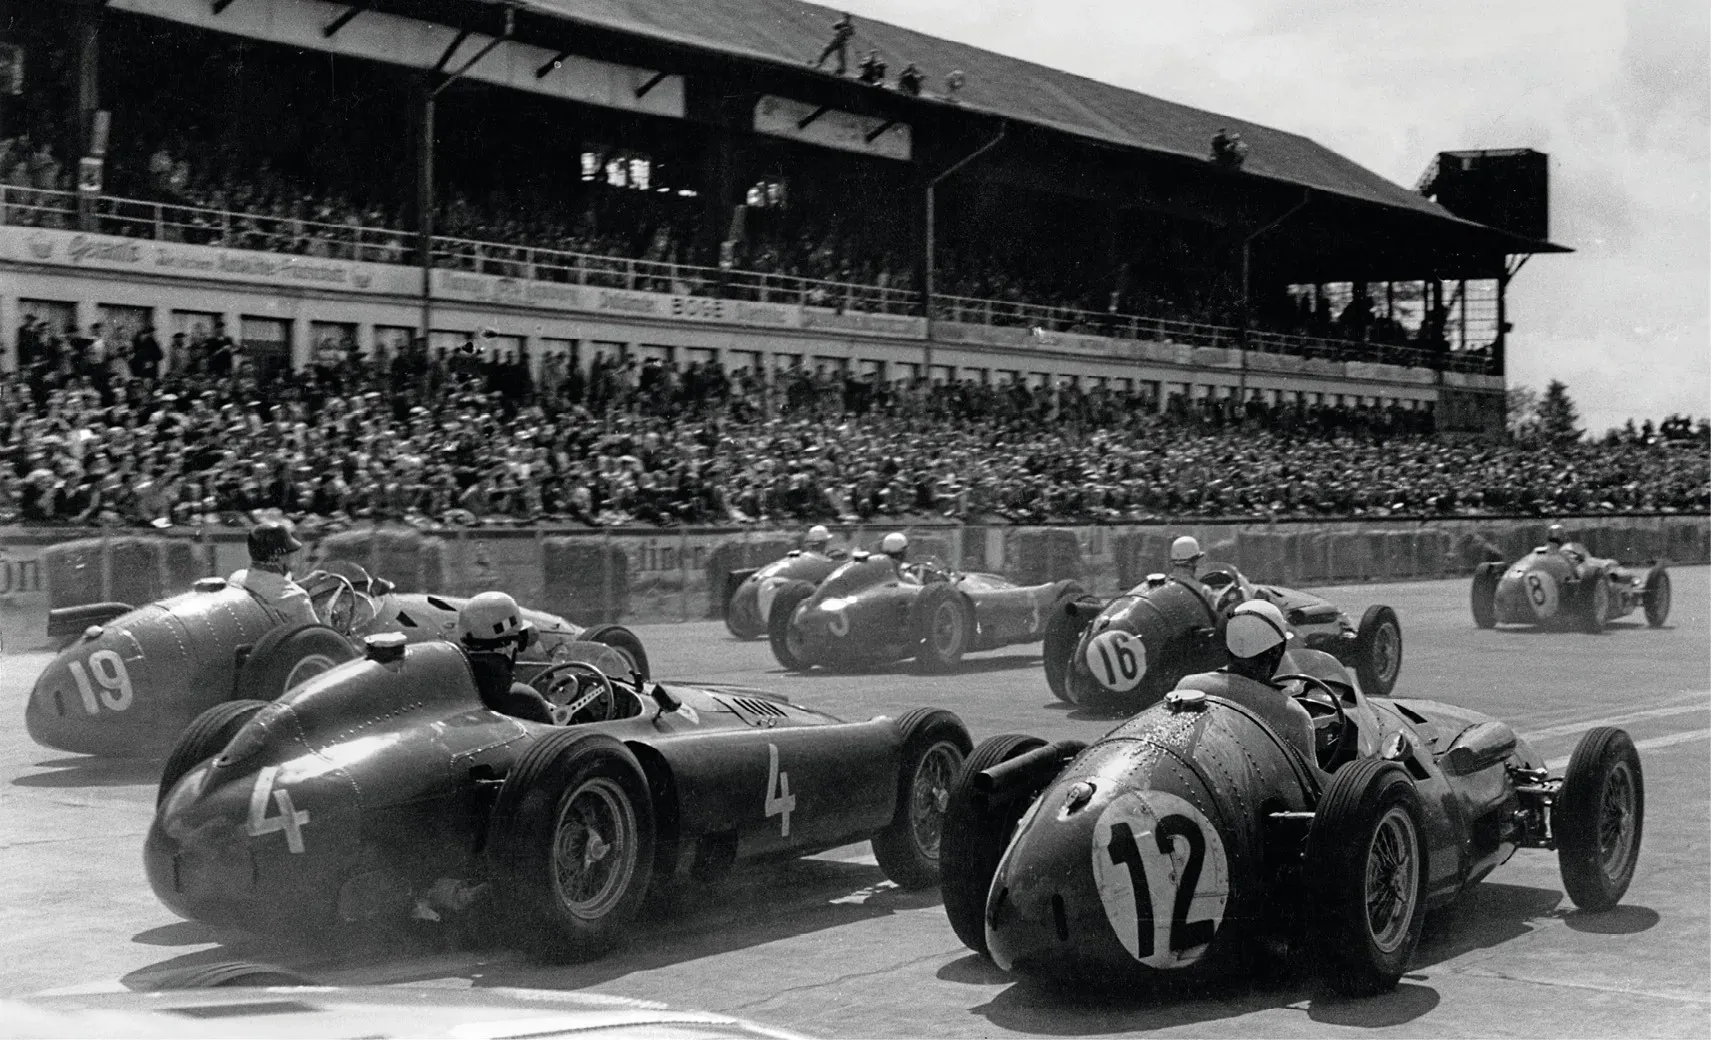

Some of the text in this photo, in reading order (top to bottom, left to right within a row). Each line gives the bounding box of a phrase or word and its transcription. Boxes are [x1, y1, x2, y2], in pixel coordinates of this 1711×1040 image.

[1528, 576, 1546, 606] 8
[68, 650, 132, 713] 19
[1093, 633, 1138, 685] 16
[247, 766, 310, 853] 4
[765, 743, 796, 836] 4
[1107, 814, 1214, 958] 12
